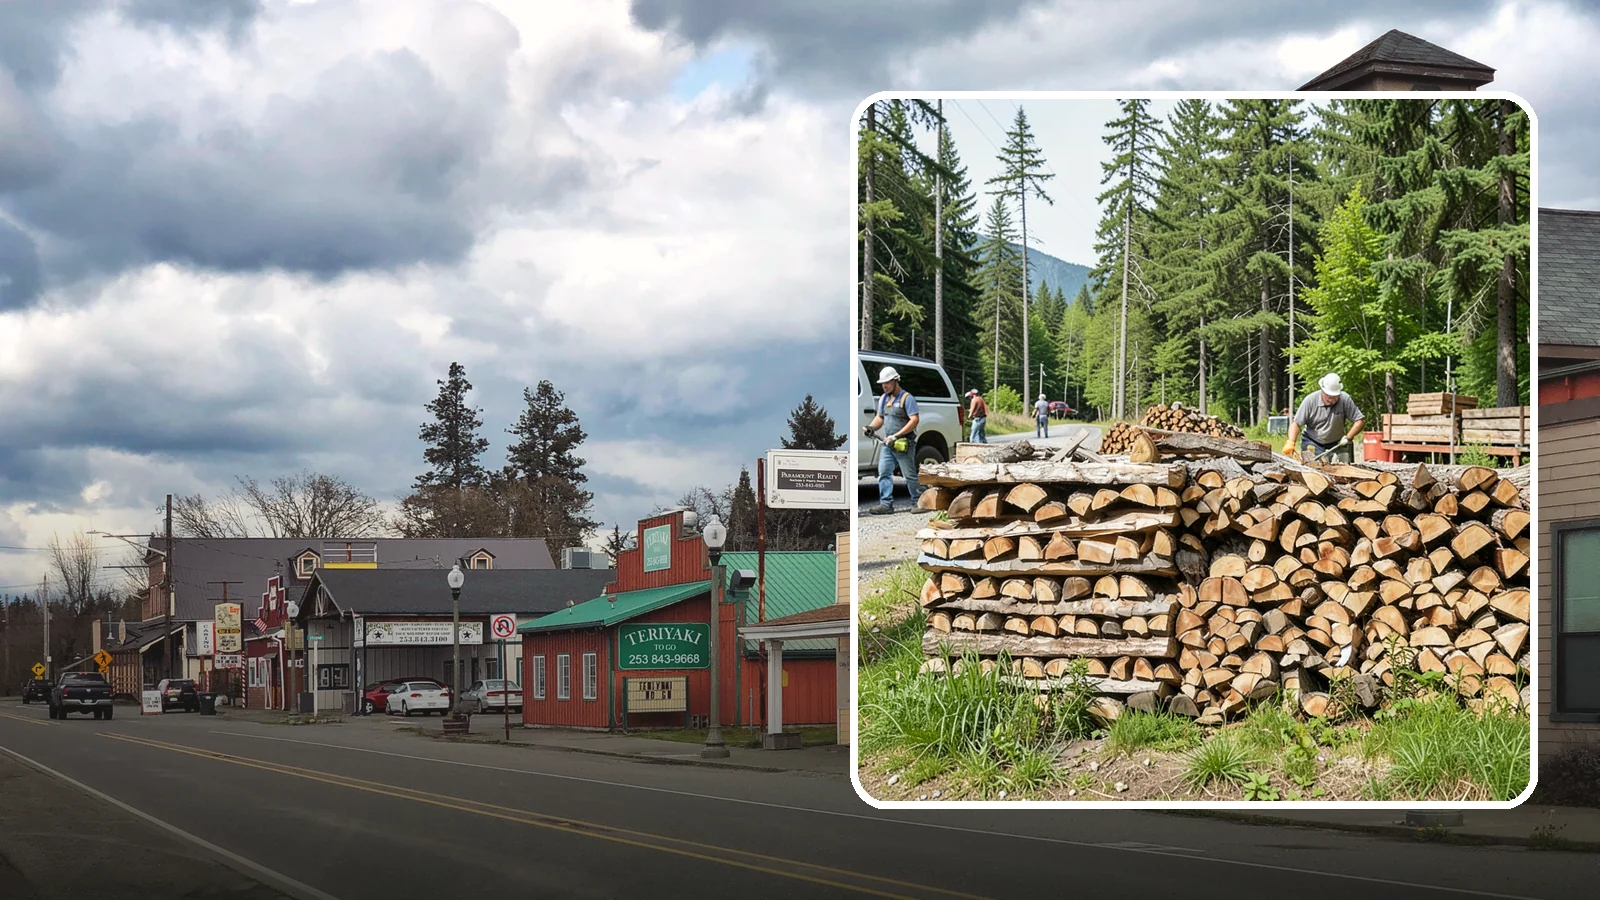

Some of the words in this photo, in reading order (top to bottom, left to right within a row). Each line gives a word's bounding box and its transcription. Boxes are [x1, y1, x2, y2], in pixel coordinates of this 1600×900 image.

[781, 471, 815, 479] PARAMOUNT
[817, 472, 839, 480] REALTY
[625, 627, 702, 646] TERIYAKI
[629, 654, 648, 665] 253
[651, 654, 700, 664] 843-9668
